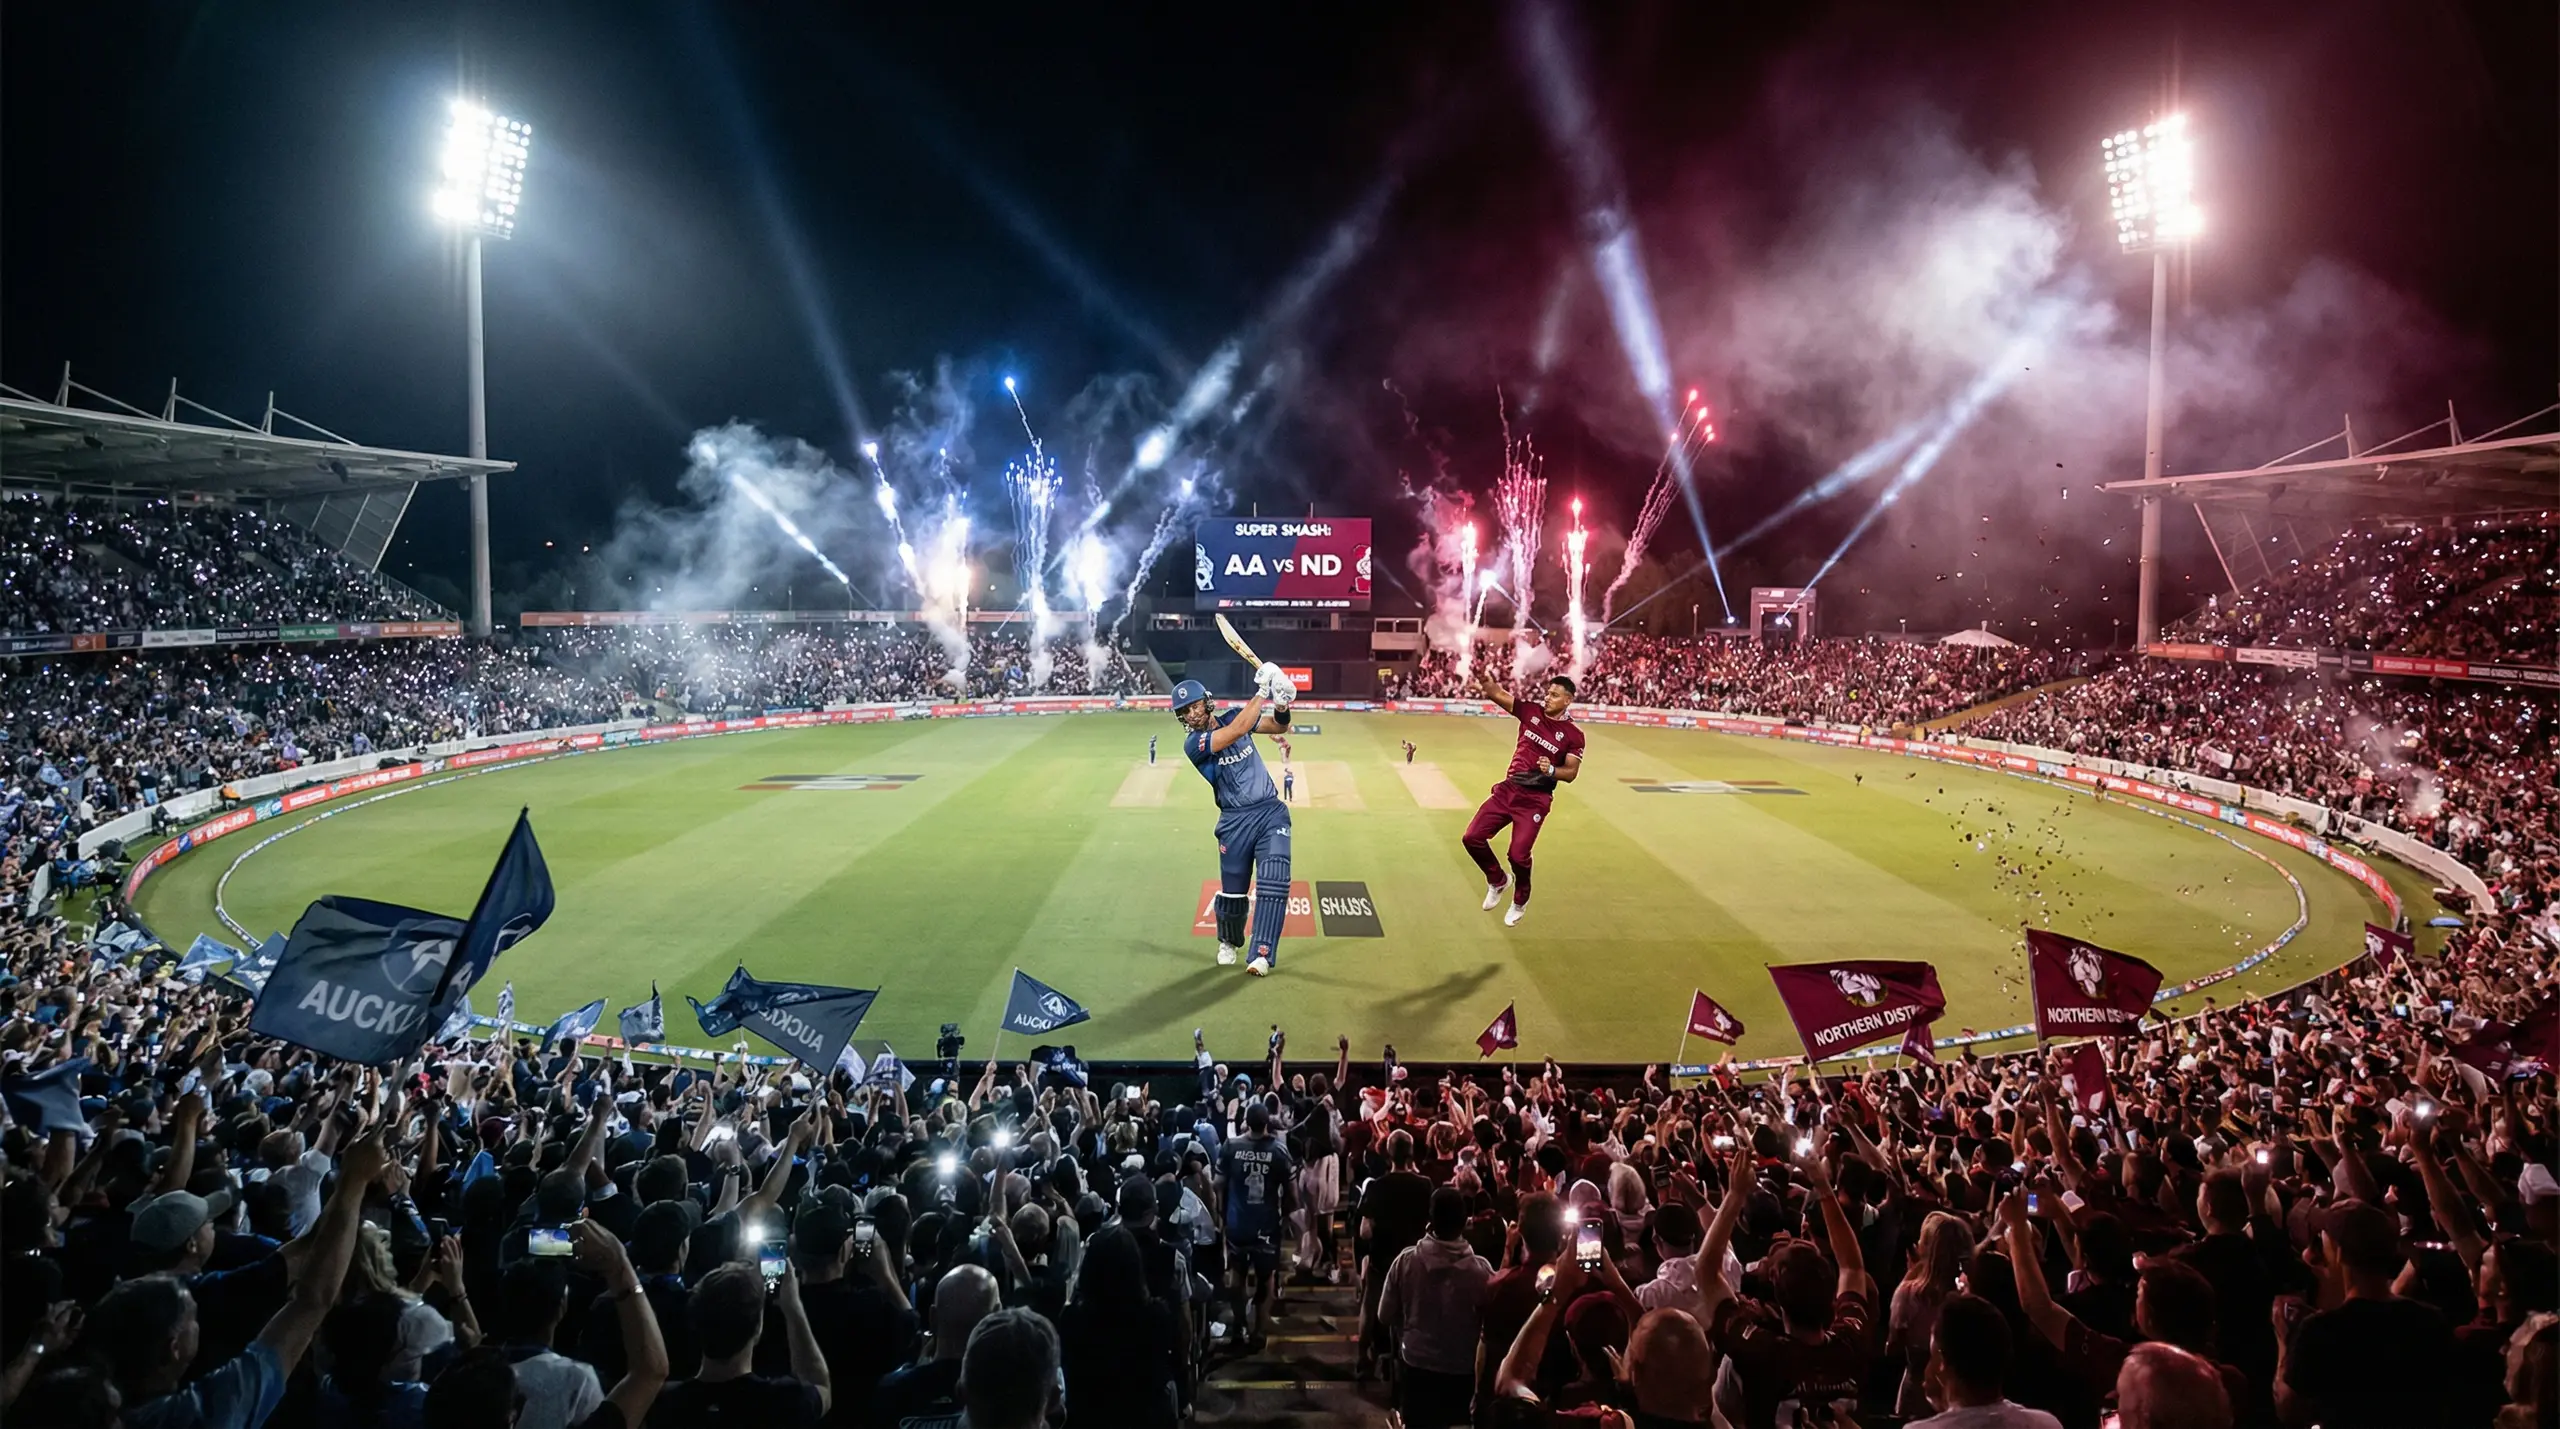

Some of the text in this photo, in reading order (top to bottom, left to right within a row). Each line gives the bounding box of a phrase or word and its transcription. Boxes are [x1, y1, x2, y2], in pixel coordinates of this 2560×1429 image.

[1235, 523, 1277, 536] SUPER
[1224, 554, 1267, 576] AA
[1301, 554, 1342, 576] ND
[2047, 1007, 2106, 1023] NORTHERN
[1814, 1012, 1883, 1047] NORTHERN
